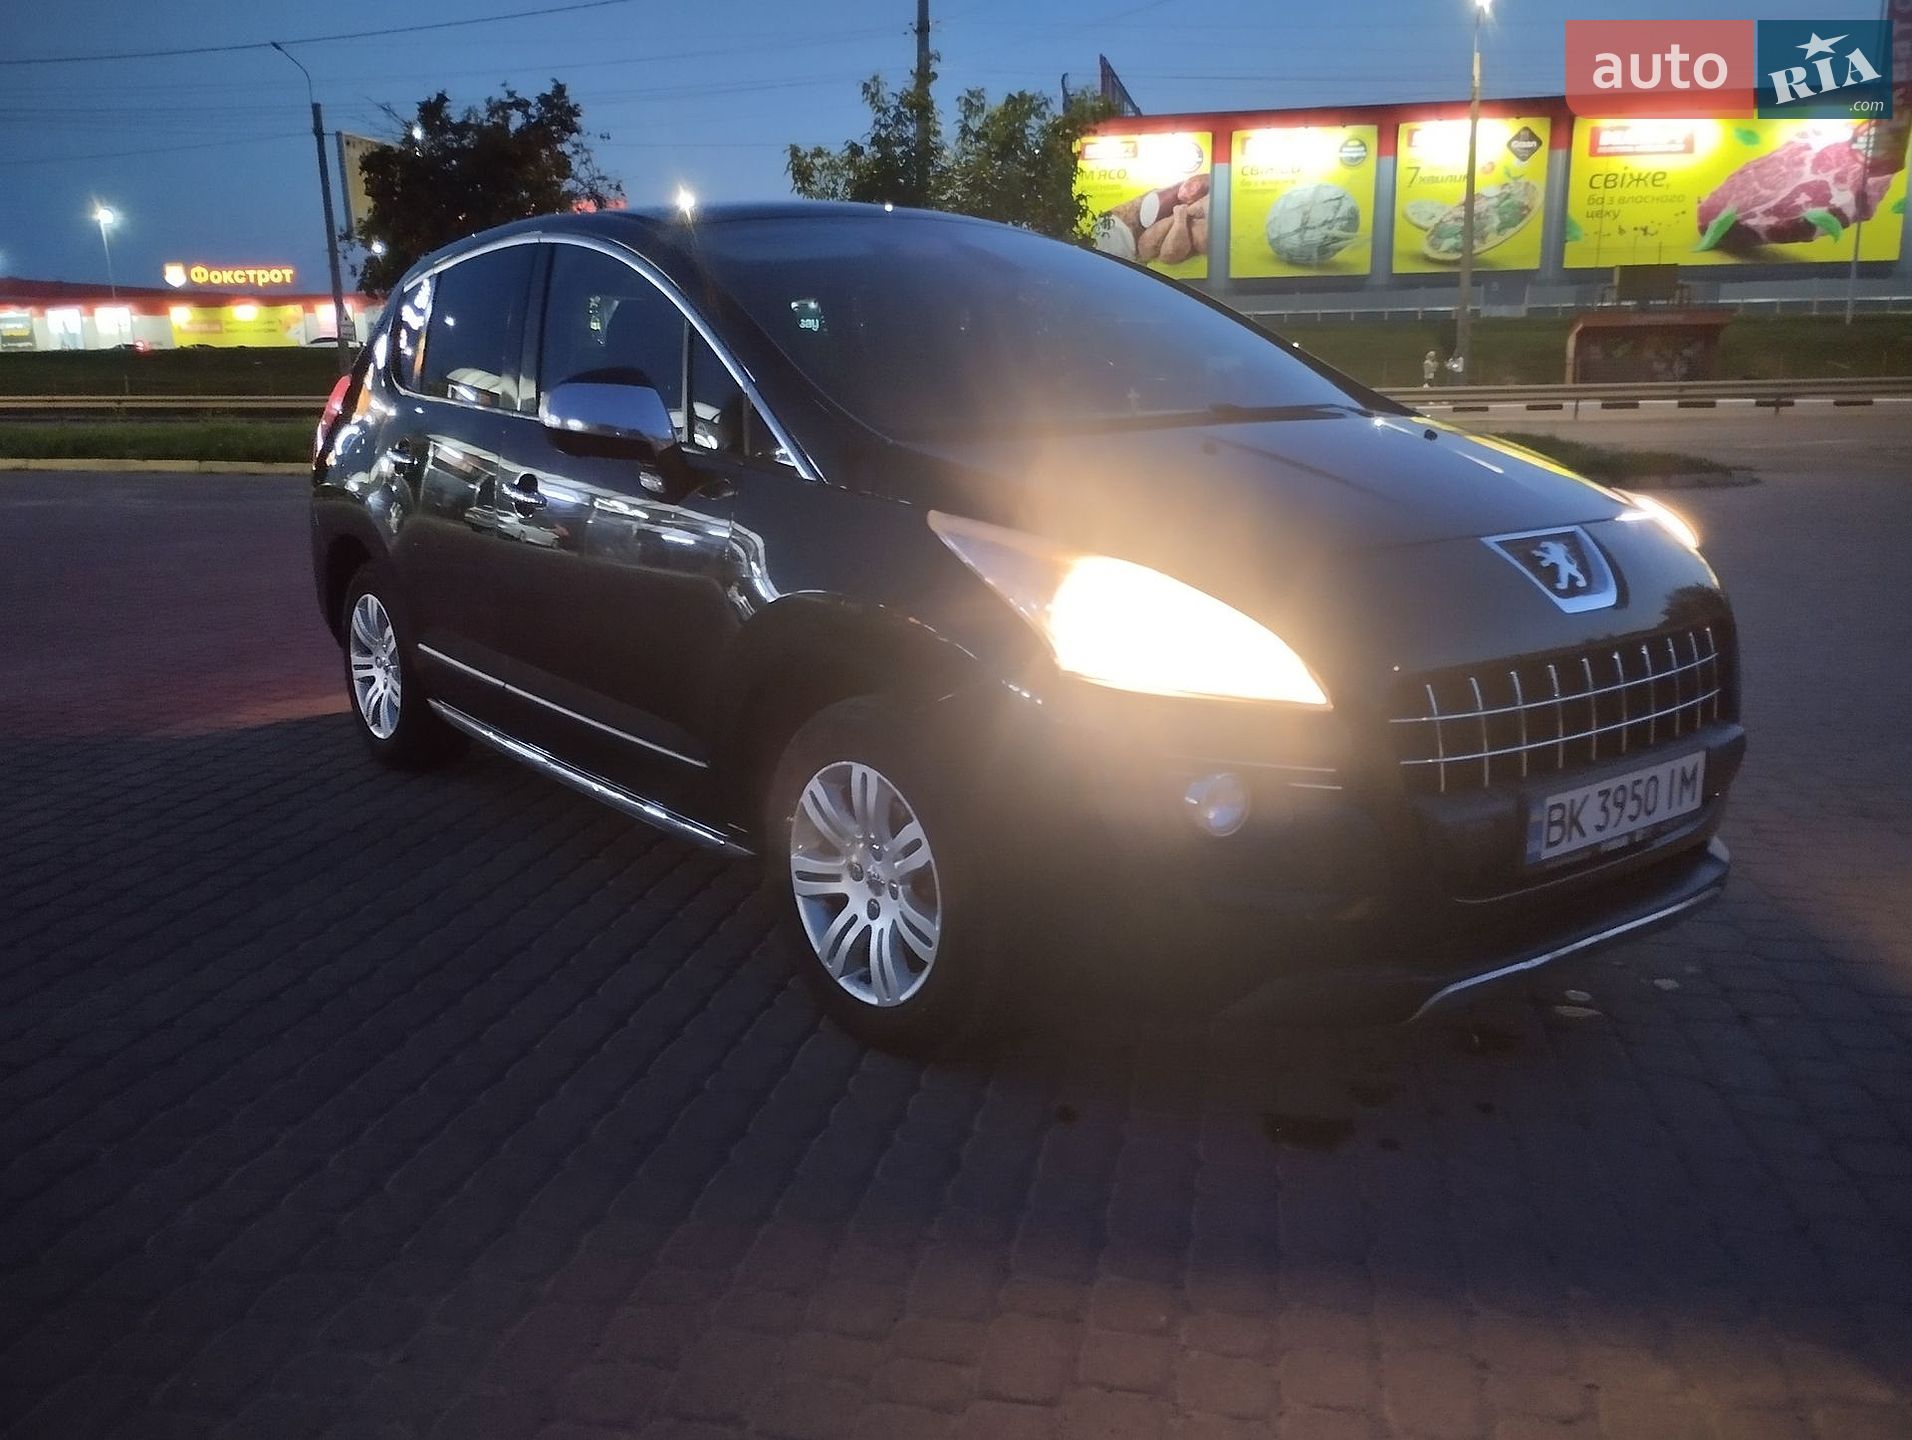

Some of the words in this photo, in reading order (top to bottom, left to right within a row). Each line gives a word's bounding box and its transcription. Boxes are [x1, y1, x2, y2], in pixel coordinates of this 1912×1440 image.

[190, 265, 294, 287] Фокстрот
[1546, 794, 1590, 849] BK
[1594, 775, 1659, 832] 3950
[1667, 762, 1699, 811] IM
